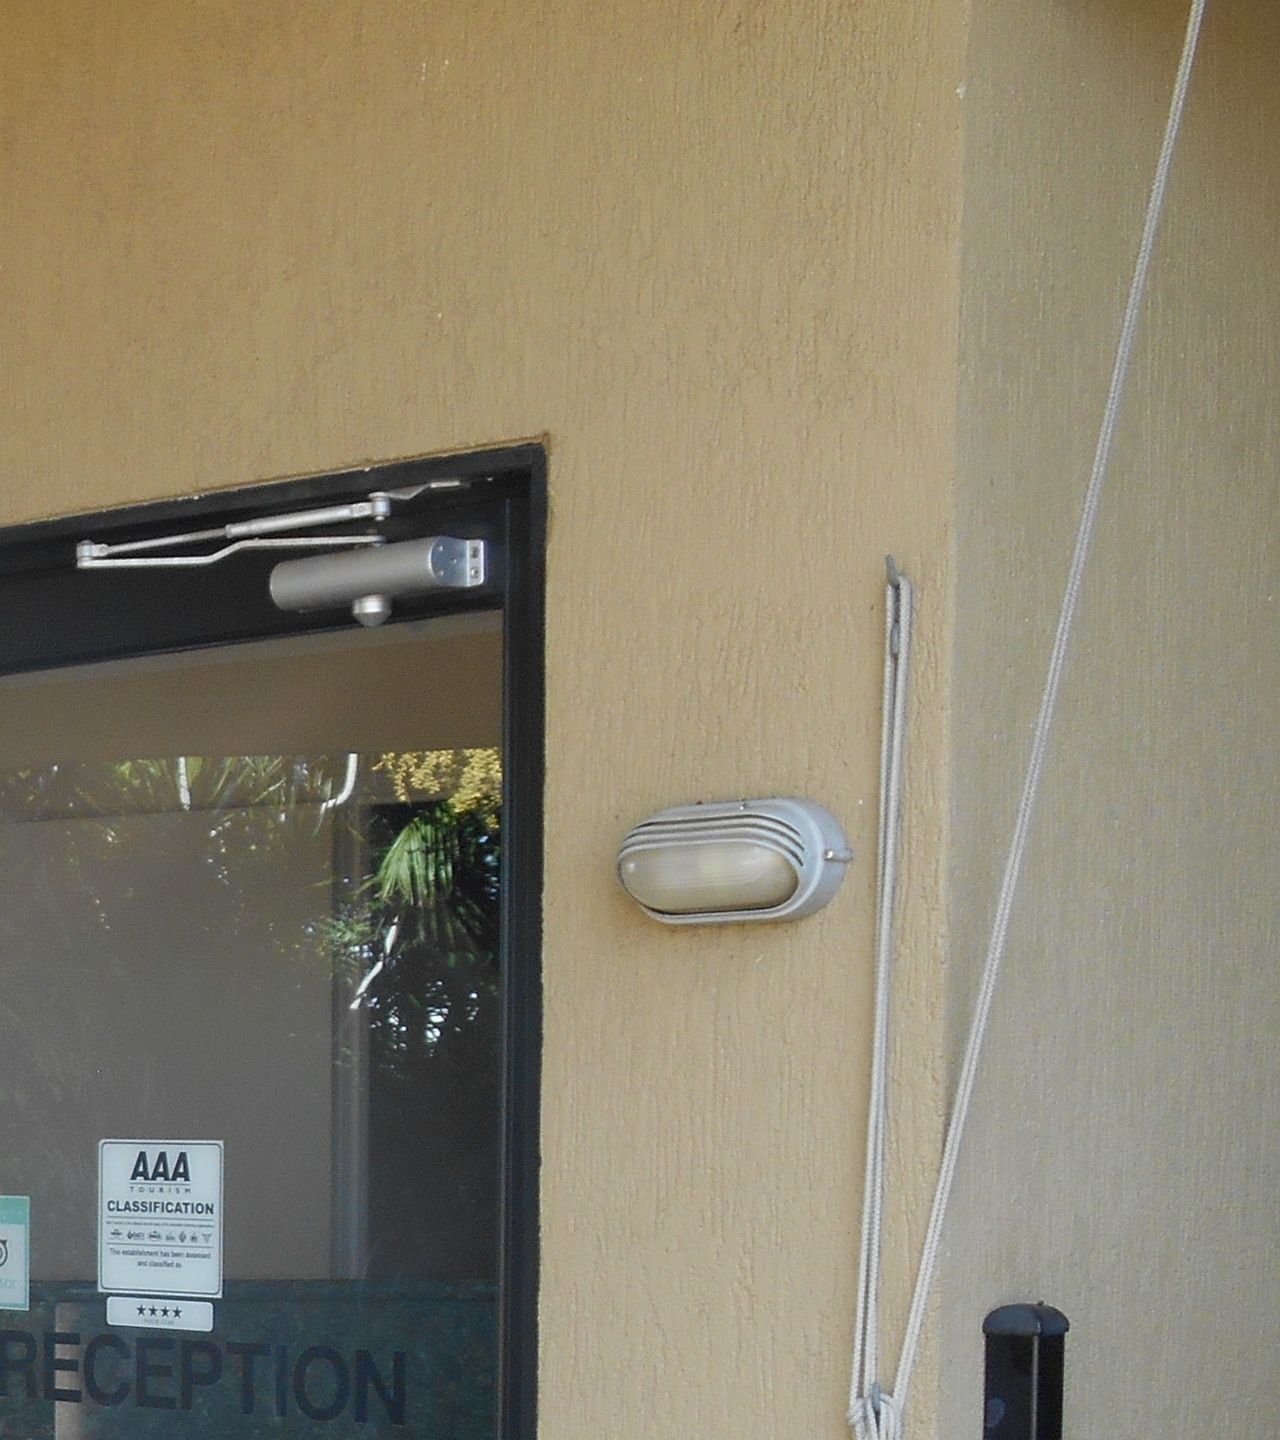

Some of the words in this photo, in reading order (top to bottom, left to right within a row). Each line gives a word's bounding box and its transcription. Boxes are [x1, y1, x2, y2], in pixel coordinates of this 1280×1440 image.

[129, 1150, 191, 1182] AAA
[129, 1186, 192, 1195] TOURISM
[107, 1200, 215, 1216] CLASSIFICATION
